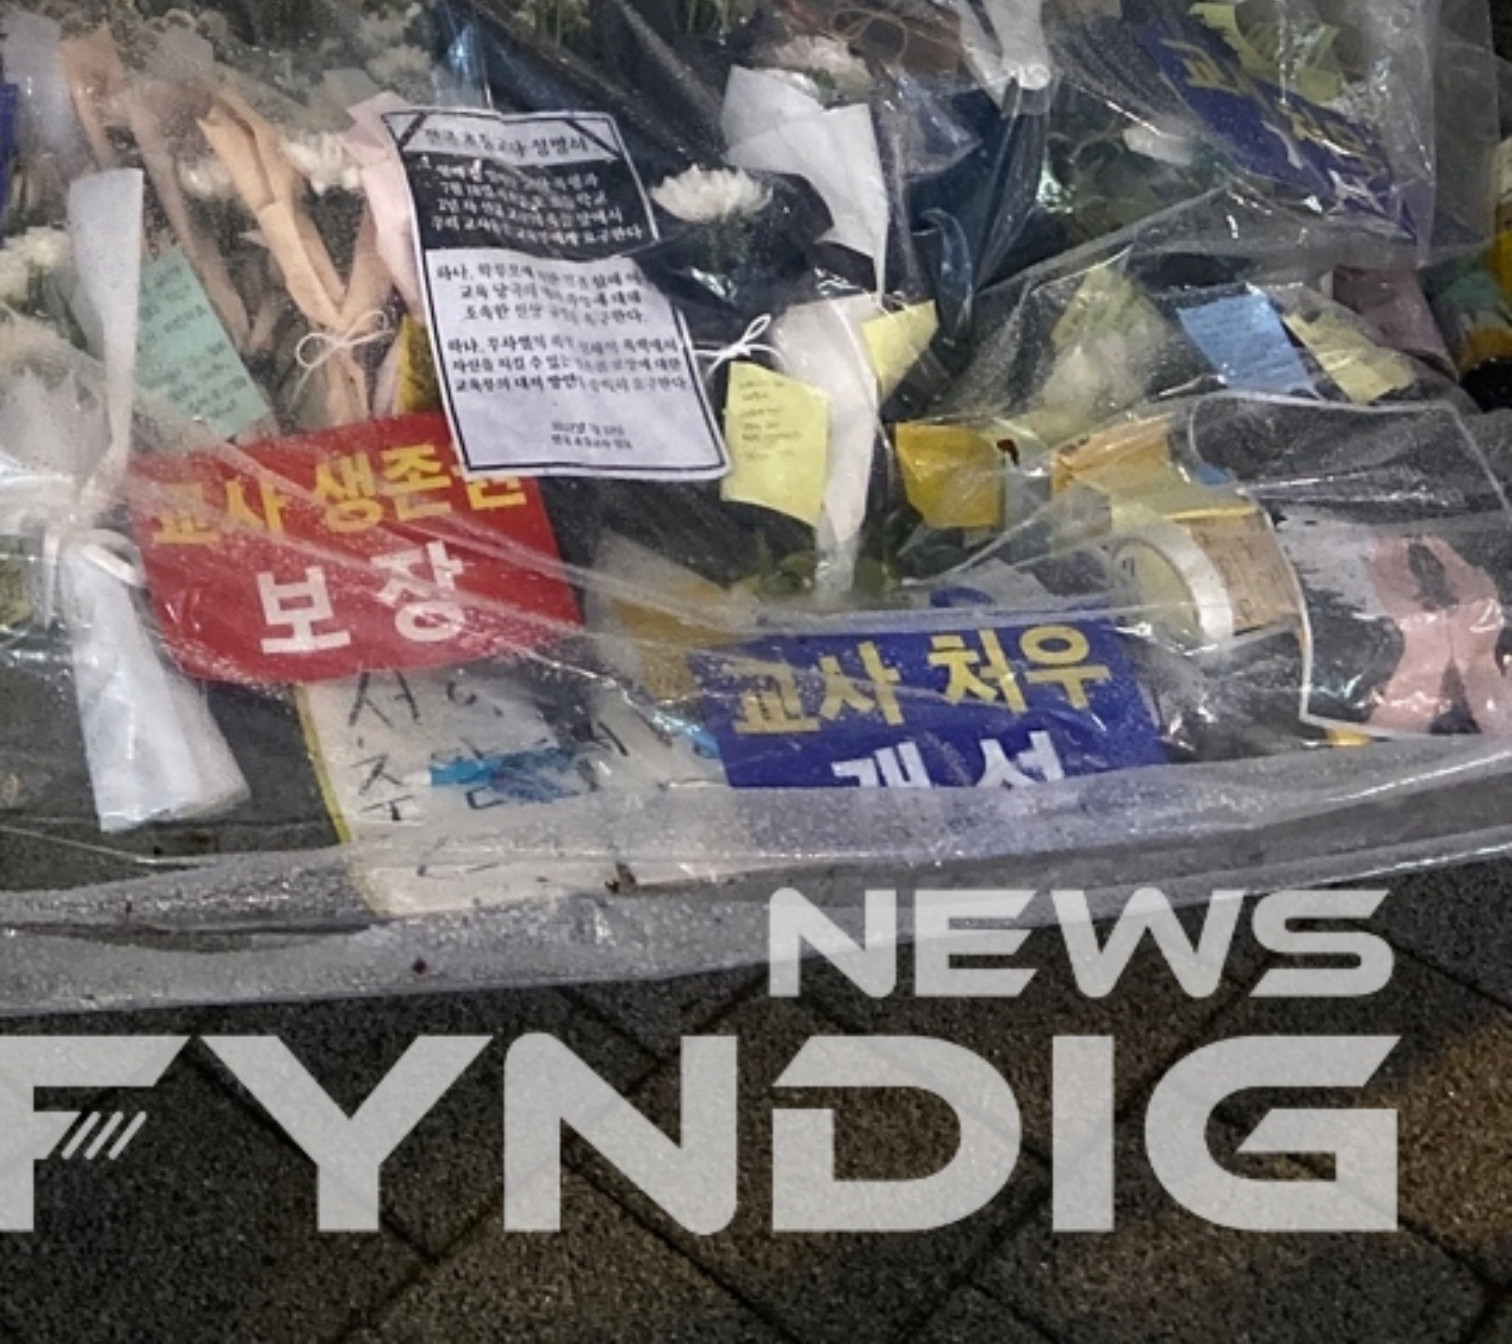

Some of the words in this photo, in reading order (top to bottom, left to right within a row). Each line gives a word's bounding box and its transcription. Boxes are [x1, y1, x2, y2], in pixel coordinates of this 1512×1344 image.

[153, 479, 289, 546] 교사
[256, 540, 466, 654] 보장
[727, 641, 905, 735] 교사
[927, 624, 1111, 714] 처우
